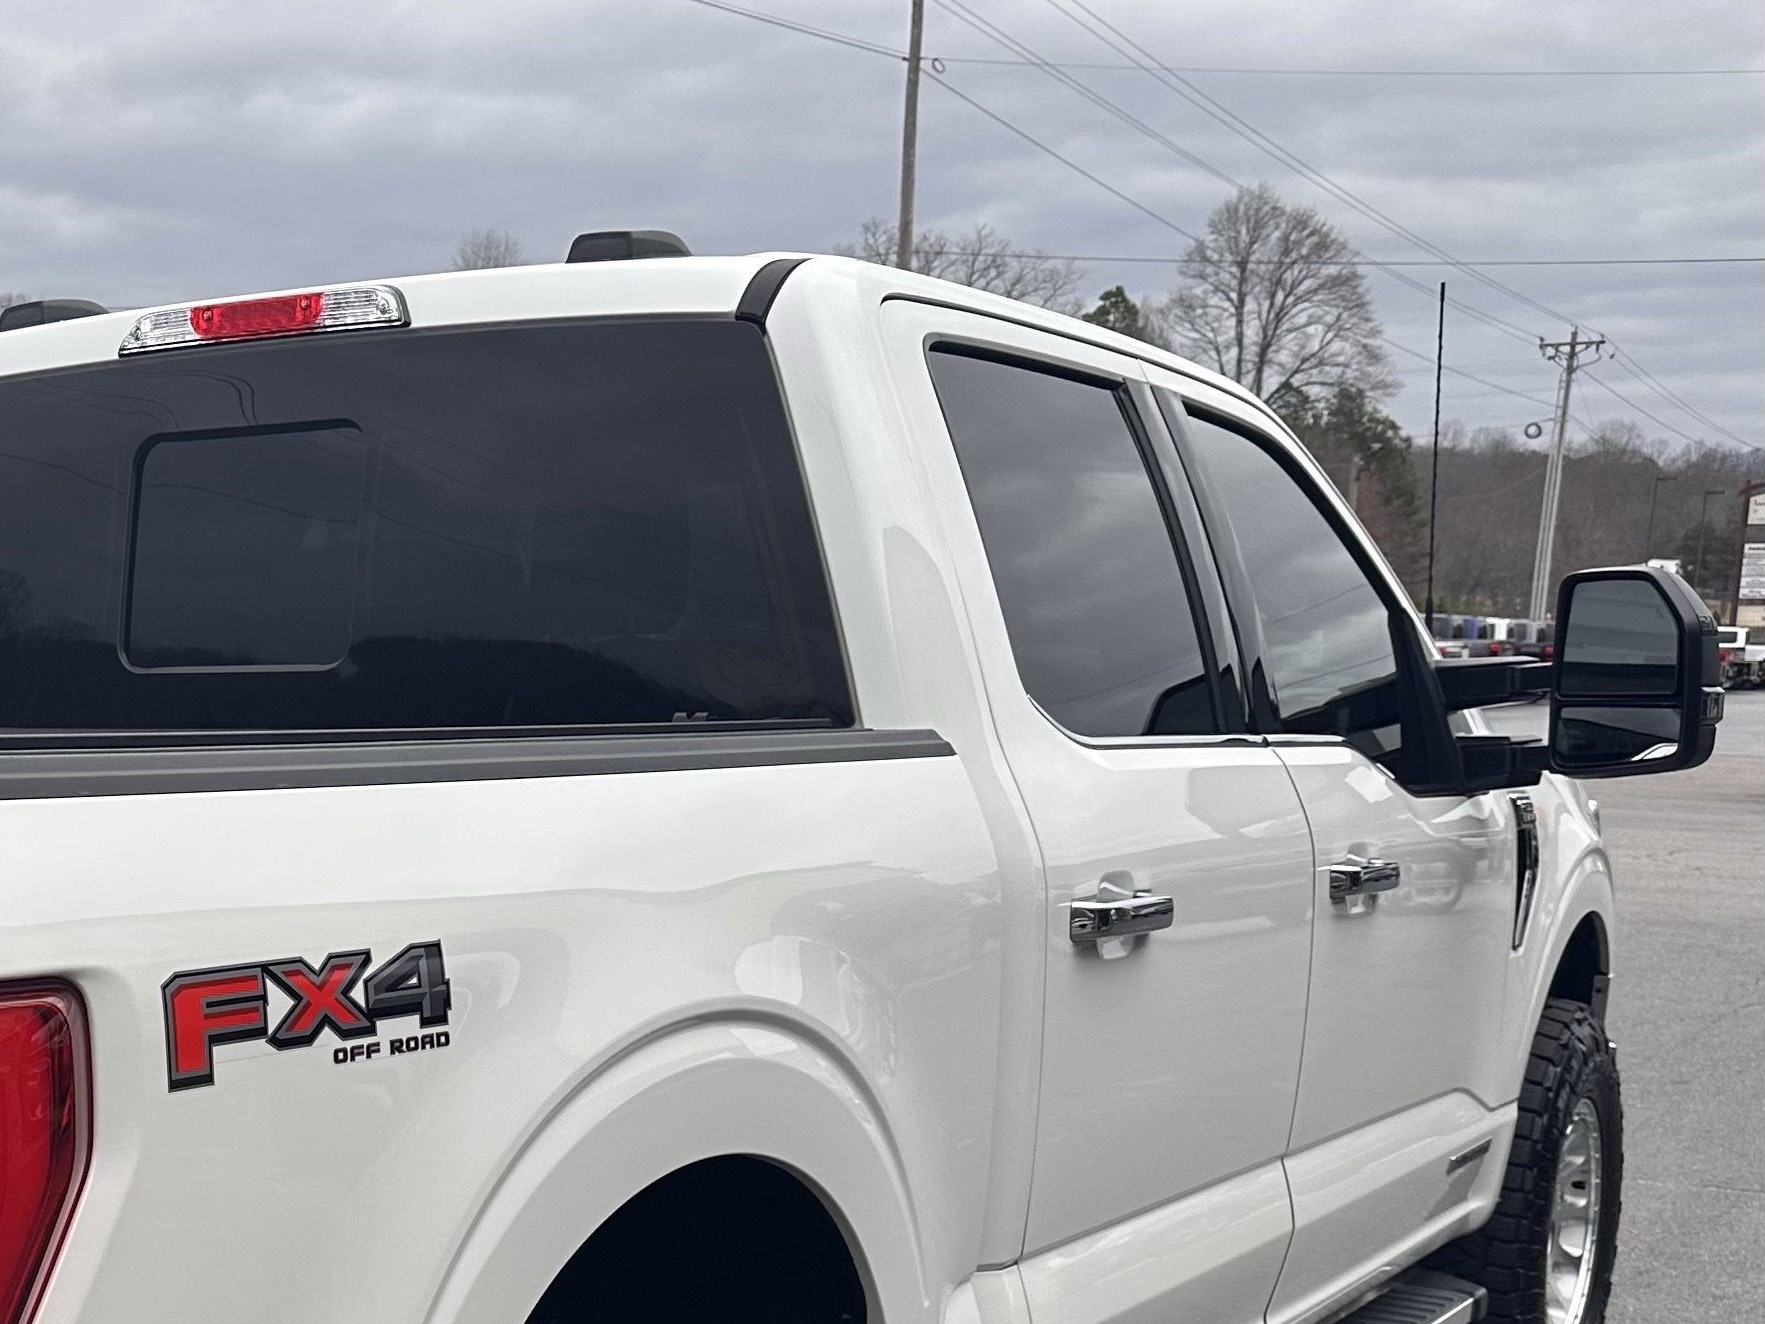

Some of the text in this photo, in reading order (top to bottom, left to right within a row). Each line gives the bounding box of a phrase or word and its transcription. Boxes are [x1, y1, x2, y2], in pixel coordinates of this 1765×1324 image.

[160, 938, 452, 1093] FX4
[332, 1030, 451, 1065] OFF ROAD
